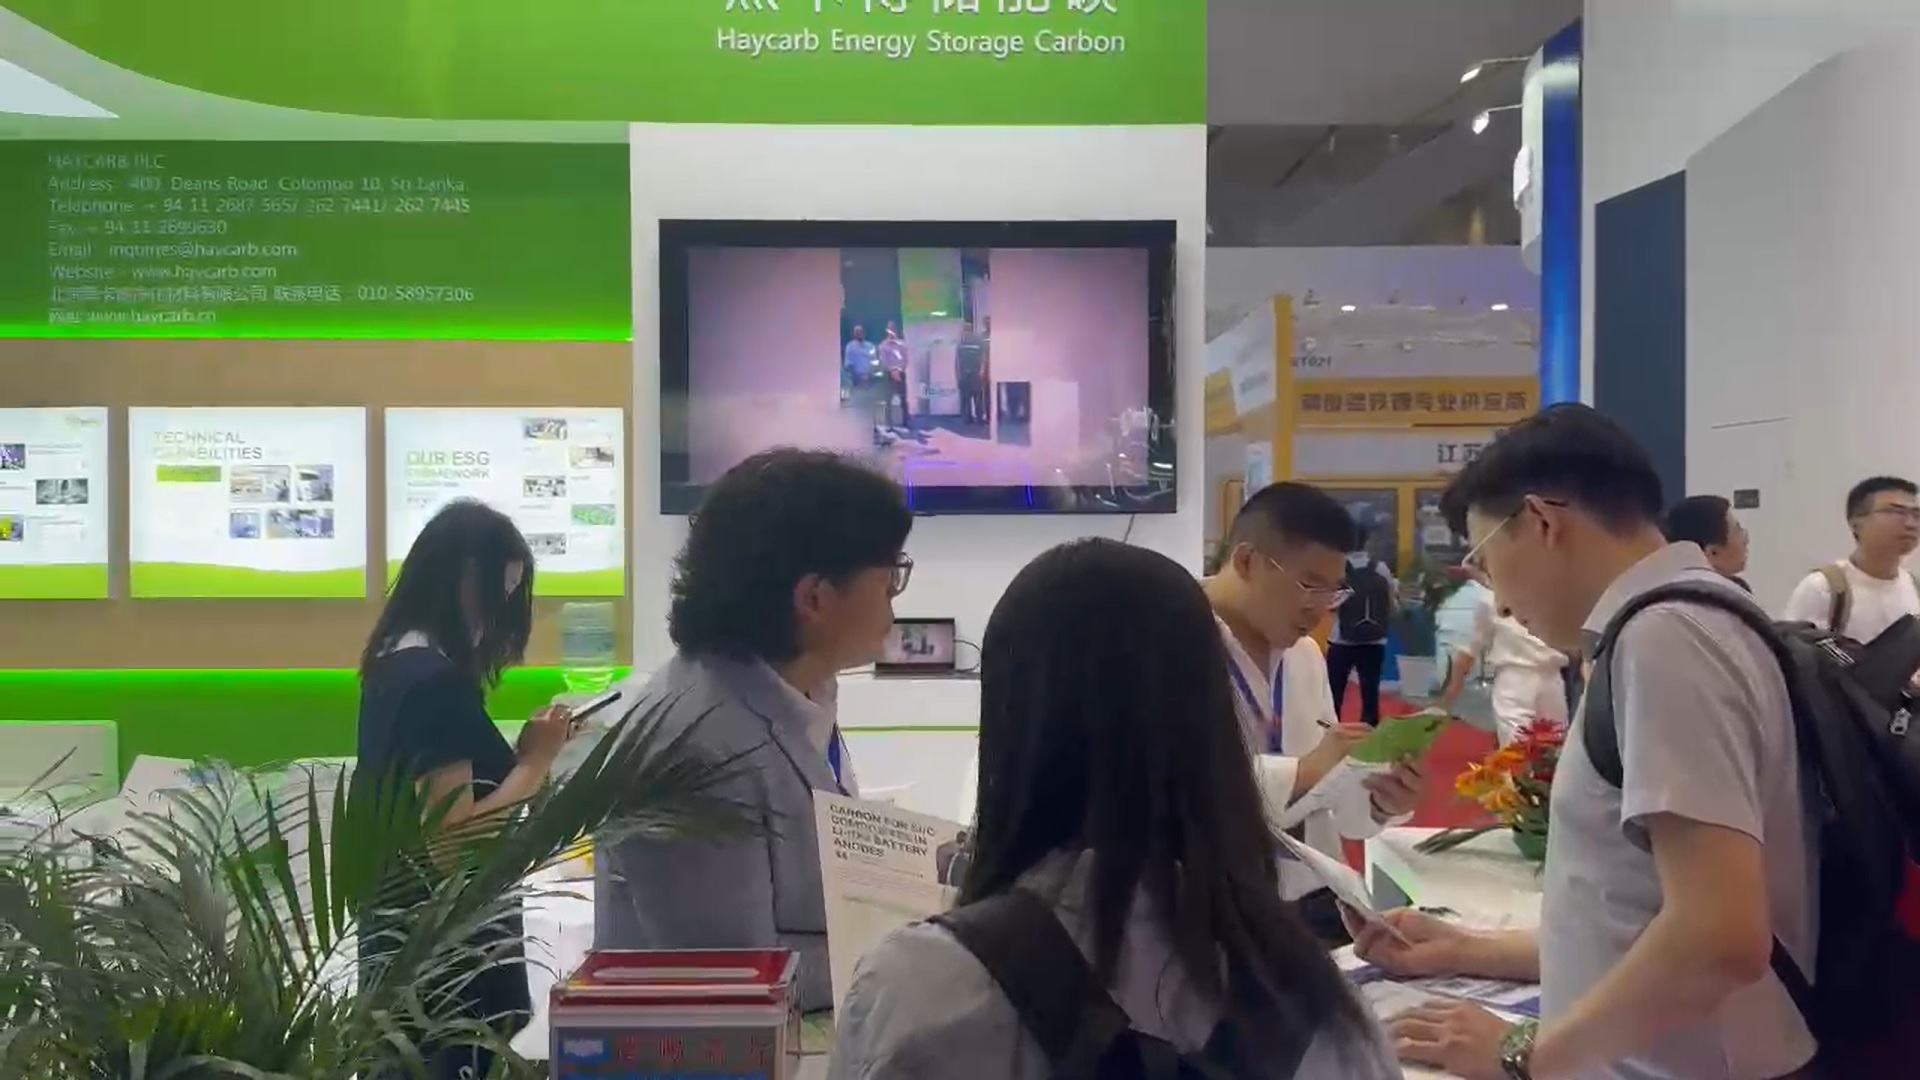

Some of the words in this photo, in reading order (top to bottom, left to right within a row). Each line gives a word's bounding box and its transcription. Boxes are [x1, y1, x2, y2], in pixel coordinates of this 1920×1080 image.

[716, 27, 820, 55] Haycarb
[830, 28, 917, 58] Energy
[926, 28, 1025, 56] Storage
[1034, 28, 1126, 54] Carbon
[162, 198, 182, 213] 94
[190, 198, 211, 213] 11
[103, 219, 124, 234] 94
[132, 219, 151, 234] 11
[153, 431, 247, 445] TECHNICAL
[407, 450, 448, 466] OUR
[452, 450, 490, 466] ESG
[407, 467, 490, 480] MEWORK
[830, 804, 881, 822] CARBON
[833, 837, 886, 858] ANODES
[873, 836, 928, 857] BATTERY
[913, 834, 928, 846] IN
